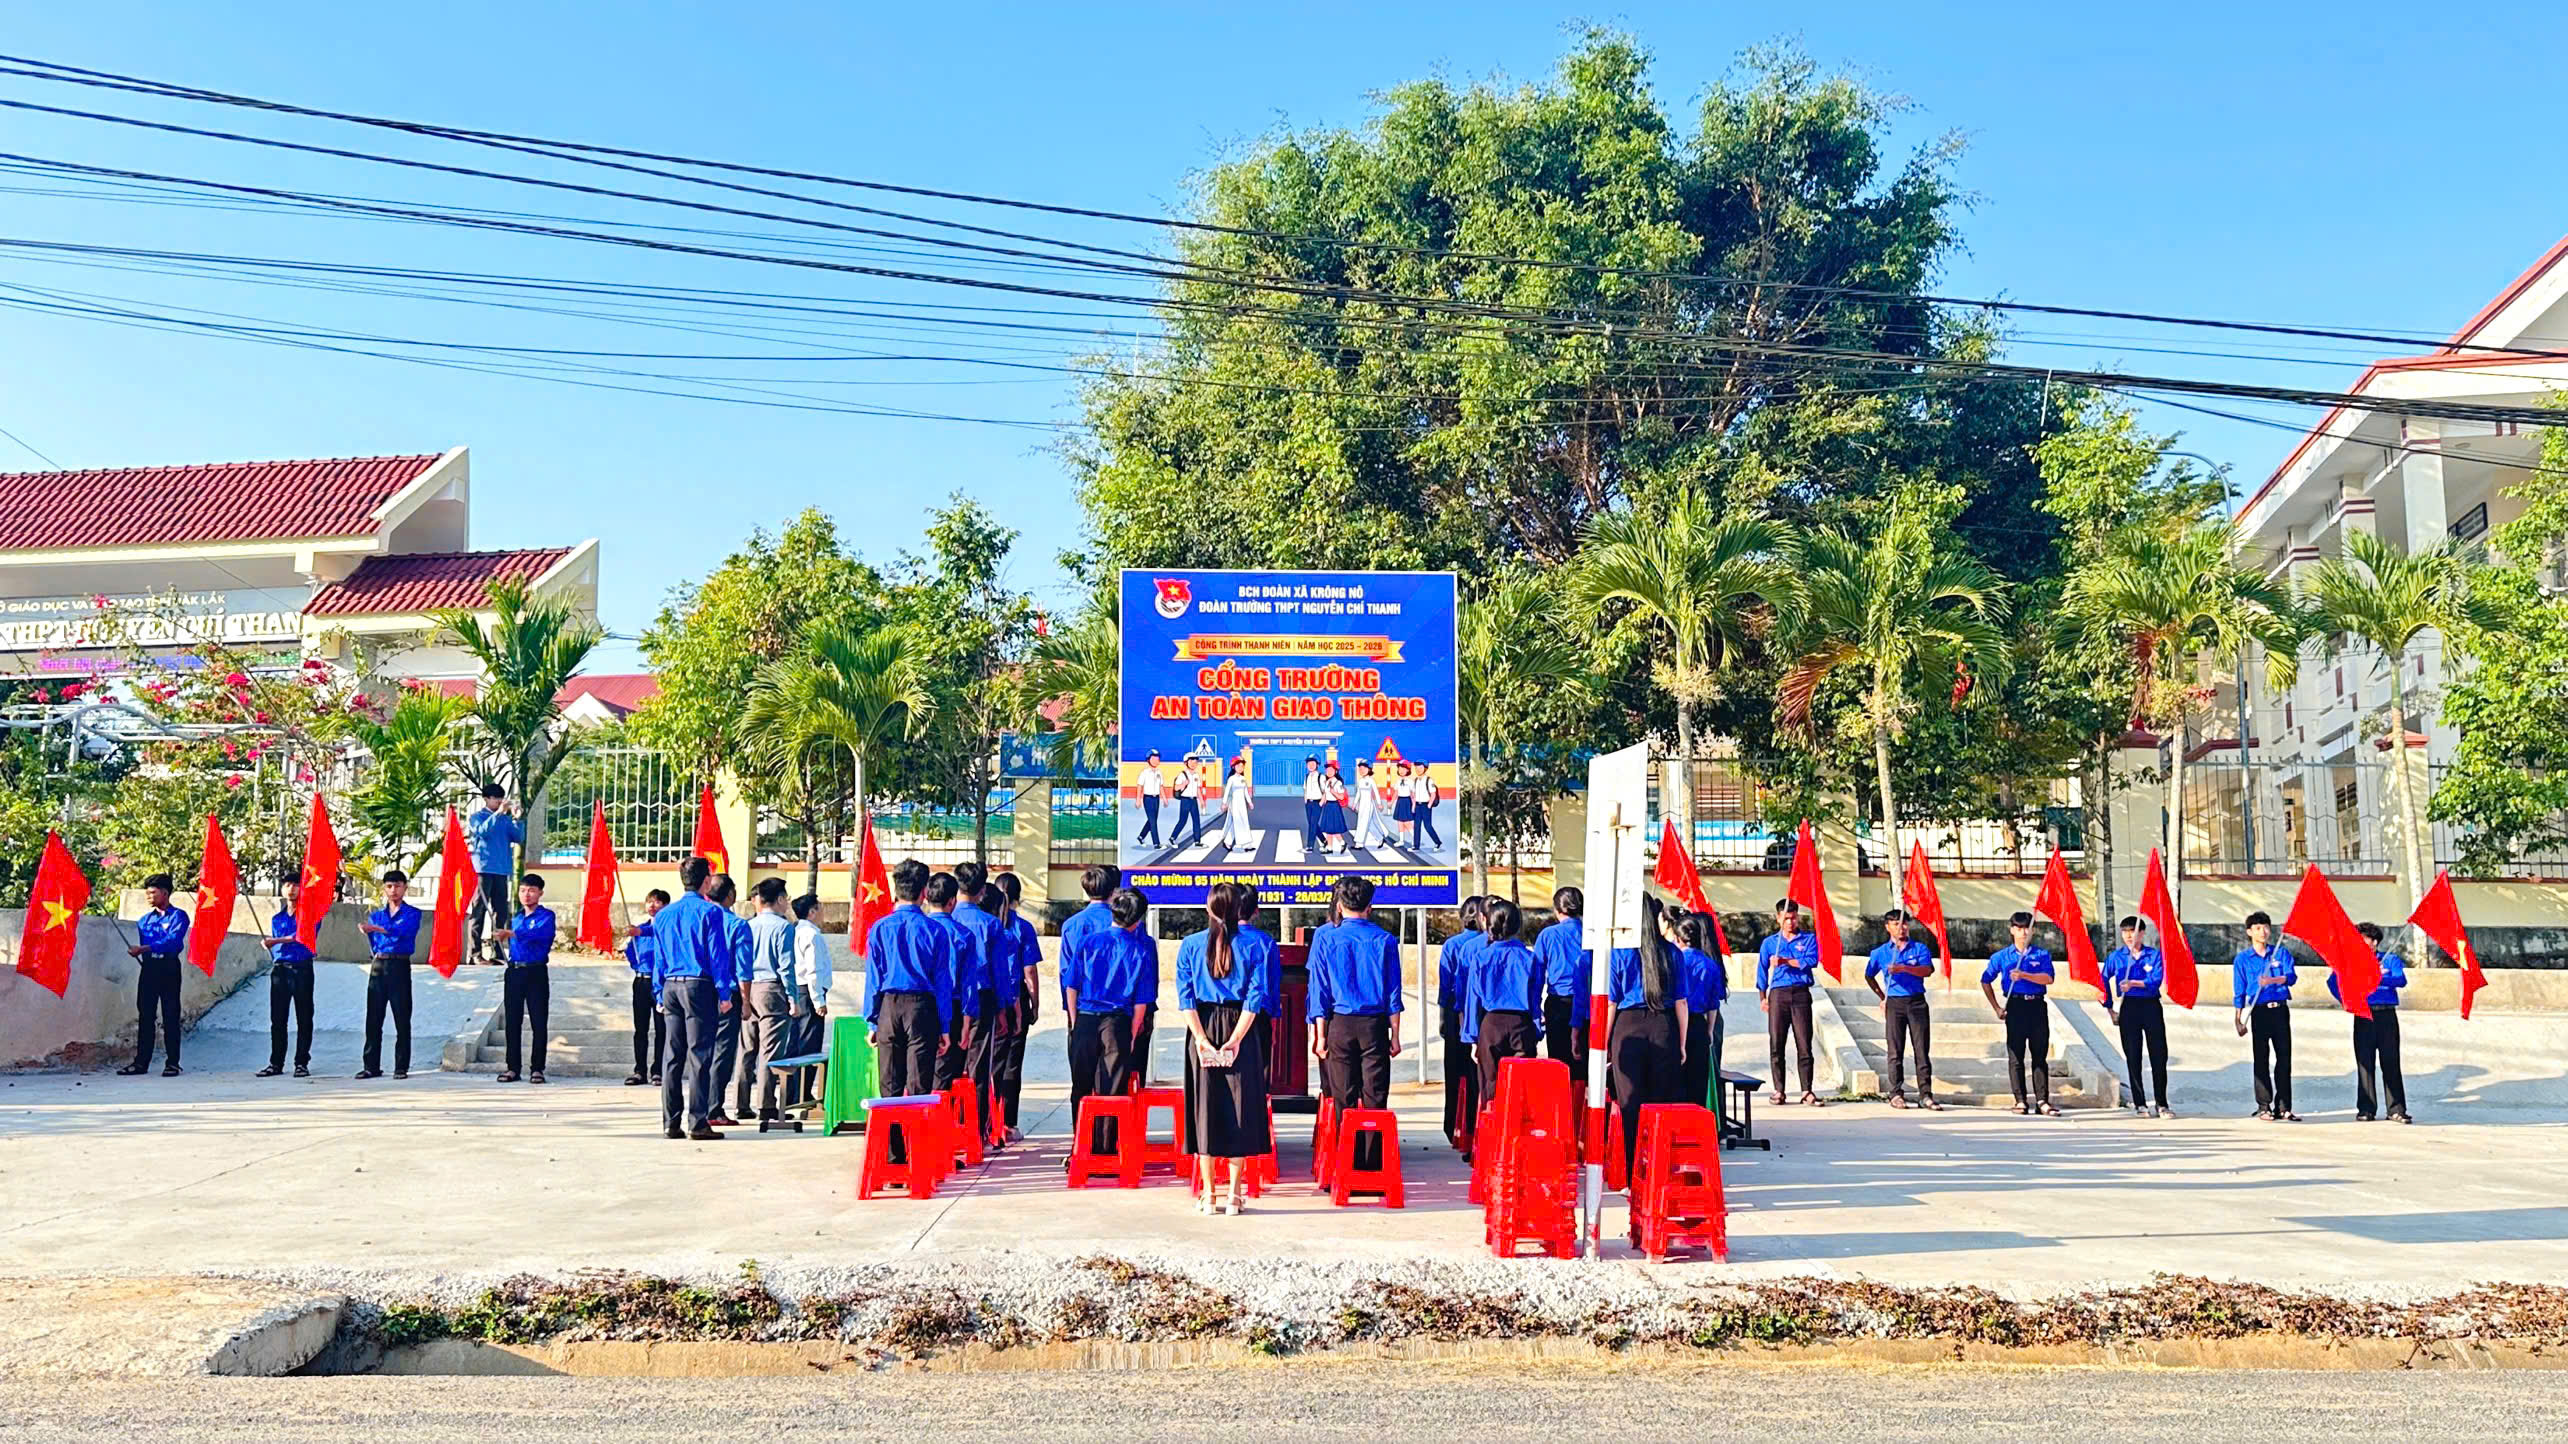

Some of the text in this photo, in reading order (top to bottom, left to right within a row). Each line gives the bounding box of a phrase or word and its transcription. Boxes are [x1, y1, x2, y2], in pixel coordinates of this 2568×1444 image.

[1239, 586, 1260, 598] BCH
[1262, 584, 1291, 598] ĐOÀN
[1293, 585, 1308, 598] XÃ
[1310, 585, 1346, 599] KRÔNG
[7, 600, 41, 613] GIÁO
[42, 601, 69, 614] DỤC
[1199, 600, 1401, 615] ĐOÀN TRƯỜNG THPT NGUYỄN CHÍ THANH
[2, 620, 70, 645] THPT
[226, 611, 302, 636] THAN
[1195, 638, 1217, 650] CÔNG
[1219, 638, 1242, 650] TRÌNH
[1244, 640, 1270, 650] THANH
[1272, 638, 1291, 650] NIÊN
[1297, 638, 1316, 650] NĂM
[1318, 640, 1333, 651] HỌC
[1335, 641, 1355, 650] 2025
[1197, 659, 1380, 692] CỔNG TRƯỜNG
[1151, 691, 1426, 721] AN TOÀN GIAO THÔNG
[1131, 873, 1159, 886] CHÀO
[1161, 873, 1193, 886] MỪNG
[1210, 873, 1235, 886] NĂM
[1237, 873, 1265, 886] NGÀY
[1267, 873, 1300, 886] THÀNH
[1303, 873, 1323, 887] LẬP
[1384, 872, 1400, 886] HỒ
[1401, 872, 1419, 886] CHÍ
[1421, 875, 1449, 886] MINH
